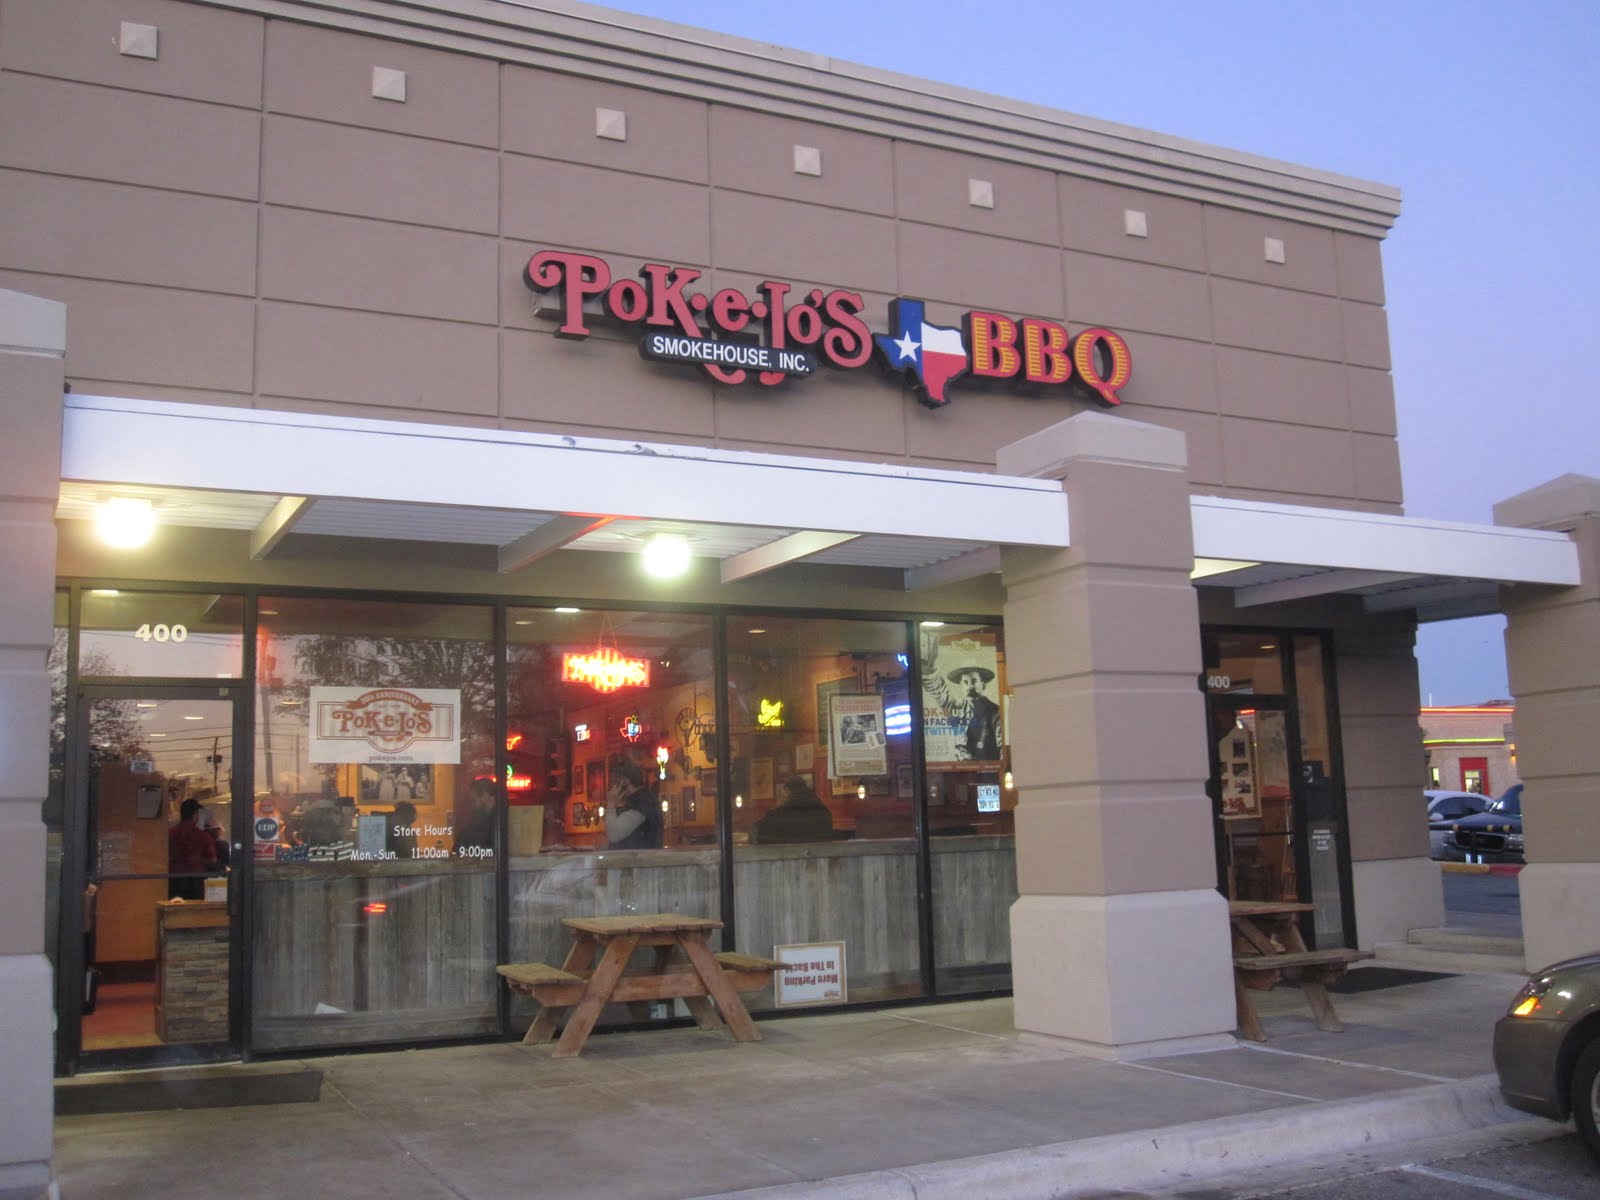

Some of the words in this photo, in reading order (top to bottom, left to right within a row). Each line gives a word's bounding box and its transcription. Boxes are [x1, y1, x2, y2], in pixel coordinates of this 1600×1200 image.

[653, 335, 772, 368] SMOKEHOUSE,
[779, 353, 810, 372] INC.
[970, 310, 1132, 406] BBQ
[135, 624, 188, 643] 400
[1207, 675, 1230, 689] 400
[393, 825, 421, 837] Store
[424, 824, 453, 836] Hours
[411, 847, 449, 859] 11:00am
[459, 845, 494, 860] 9:00pm
[810, 961, 825, 971] The
[784, 975, 816, 986] Parking
[818, 974, 838, 984] More
